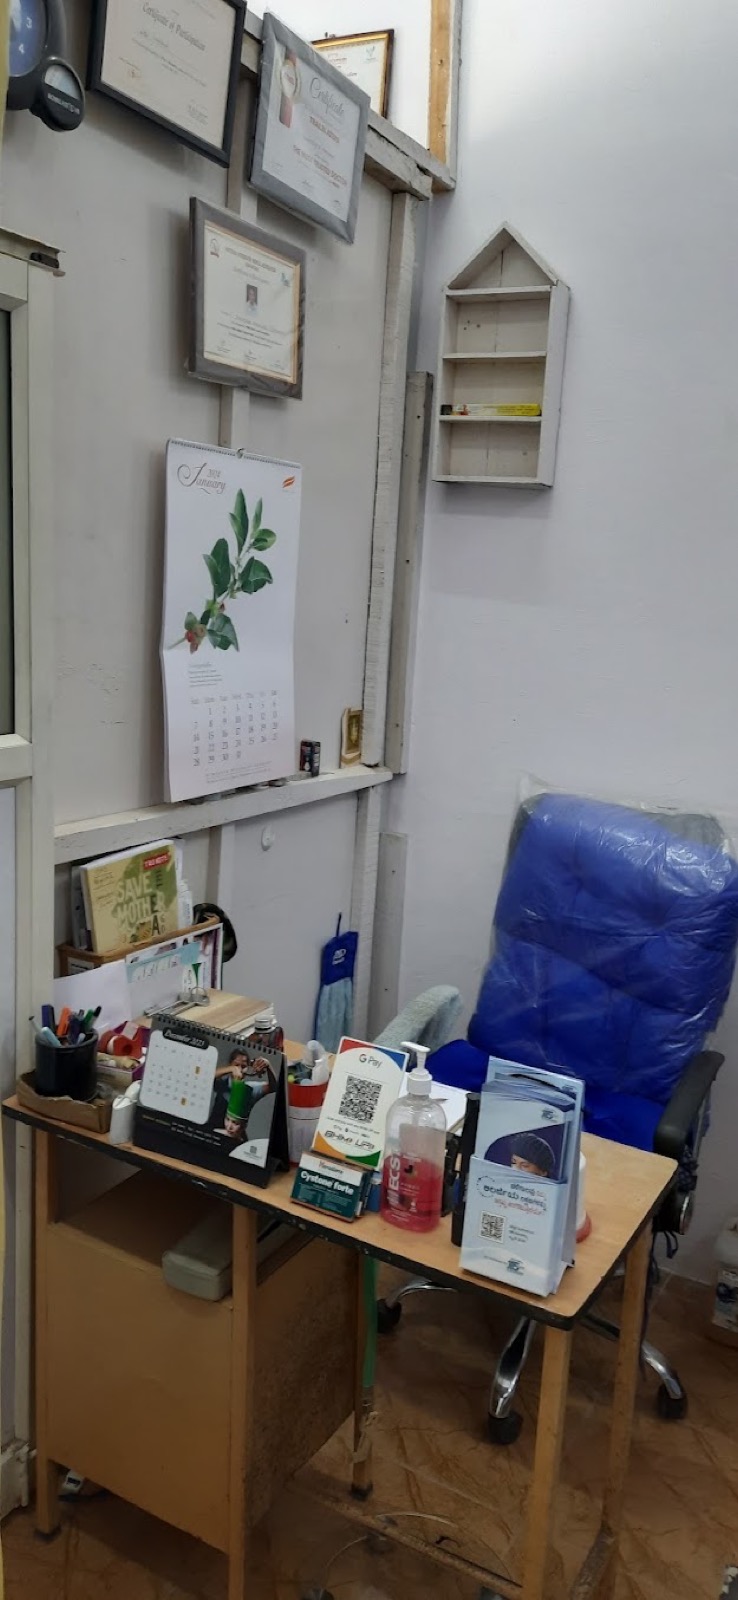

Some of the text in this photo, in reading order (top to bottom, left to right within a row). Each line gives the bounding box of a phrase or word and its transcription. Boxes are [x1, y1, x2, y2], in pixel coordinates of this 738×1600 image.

[26, 17, 33, 29] 3
[18, 43, 25, 55] 4
[176, 462, 227, 495] January
[117, 872, 153, 901] SAVE
[164, 1028, 193, 1045] December
[359, 1053, 383, 1069] G Pay
[300, 1171, 355, 1196] Cystone forte
